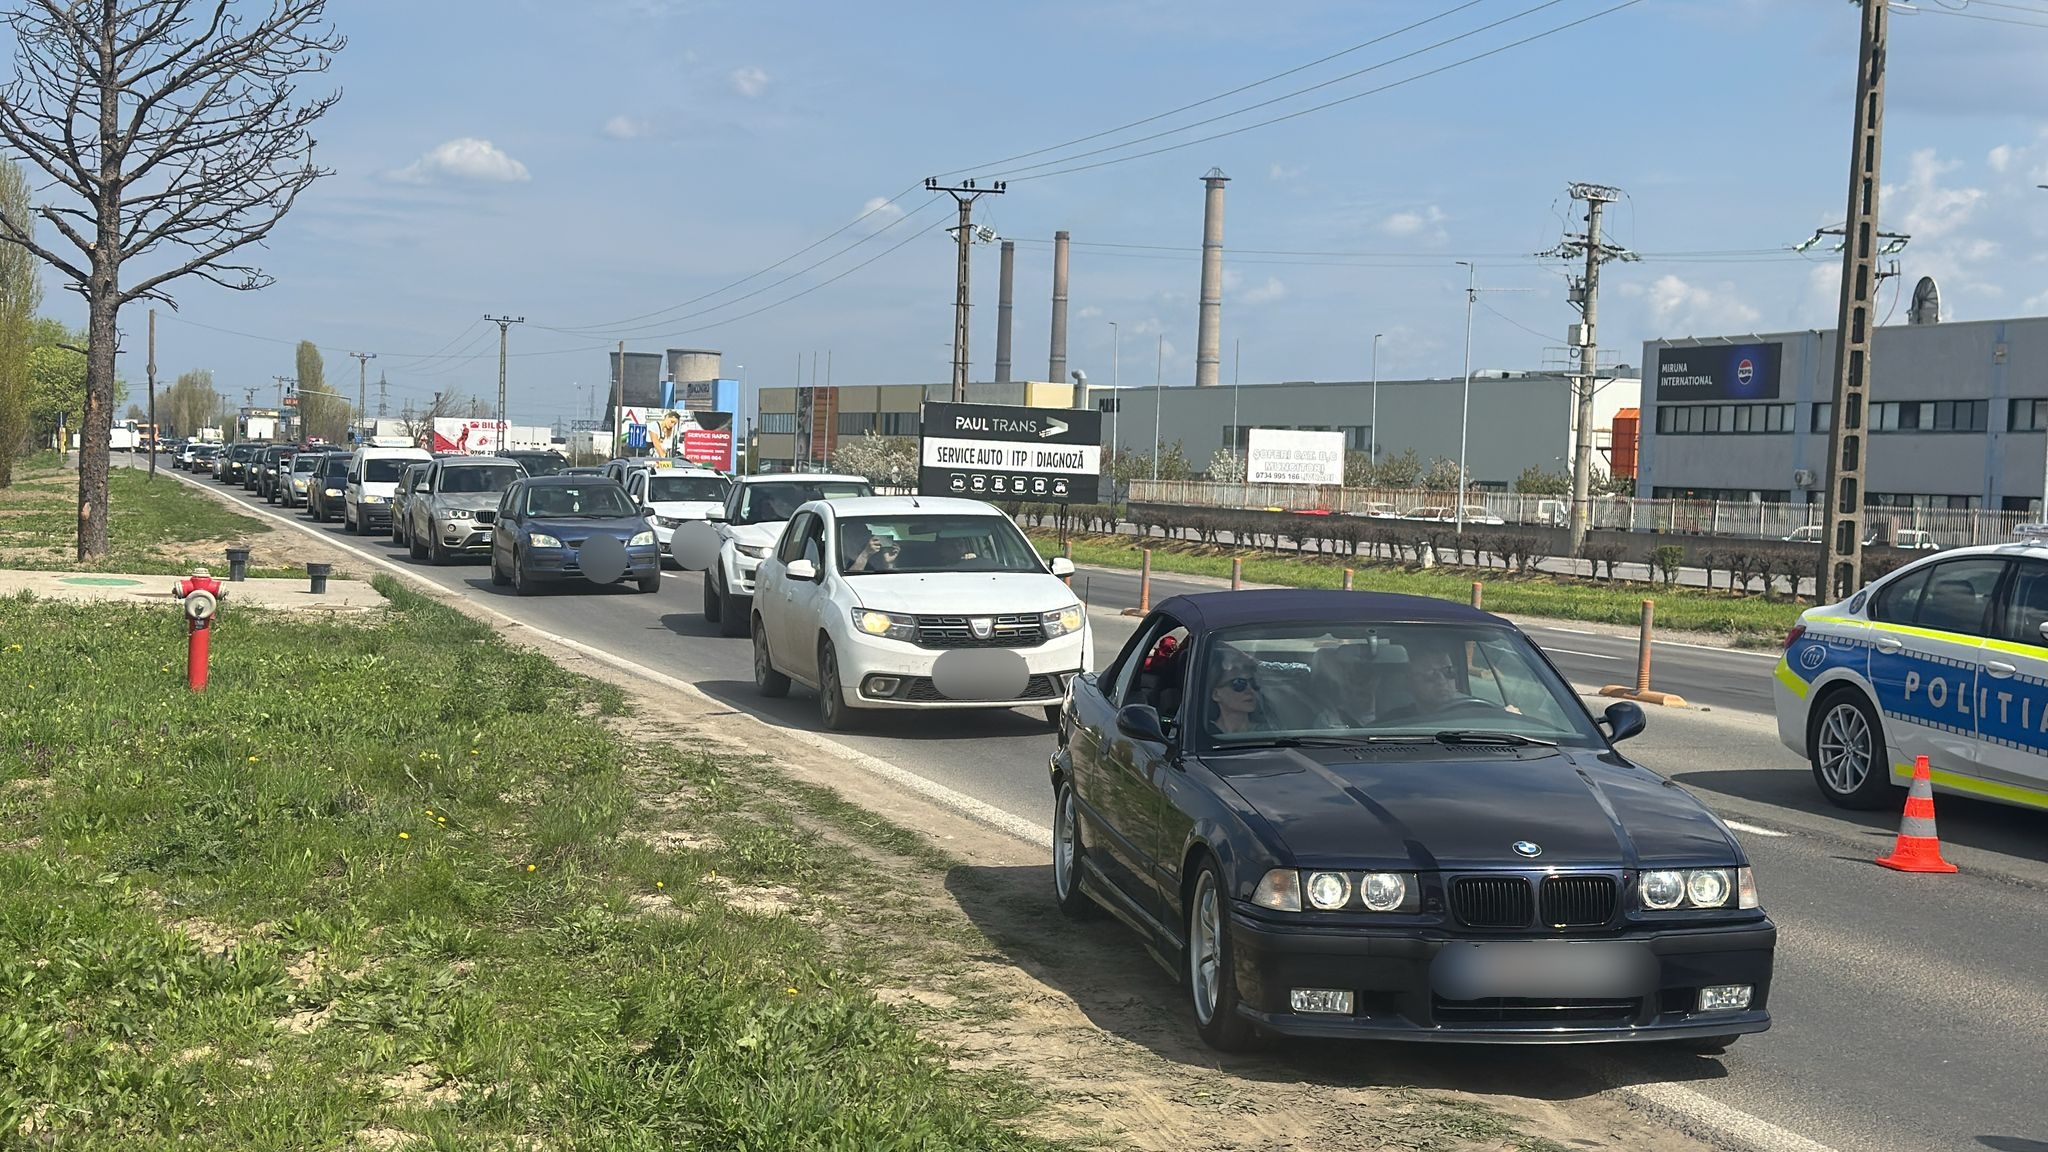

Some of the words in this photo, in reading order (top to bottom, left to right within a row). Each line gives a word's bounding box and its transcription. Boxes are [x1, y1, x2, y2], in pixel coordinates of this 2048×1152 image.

[1662, 363, 1688, 373] MIRUNA
[1661, 376, 1713, 386] INTERNATIONAL
[955, 416, 989, 431] PAUL
[992, 418, 1037, 433] TRANS
[937, 446, 975, 464] SERVICE
[976, 449, 1003, 466] AUTO
[1012, 450, 1028, 467] ITP
[1036, 450, 1084, 469] DIAGNOZĂ
[1806, 653, 1821, 665] 112
